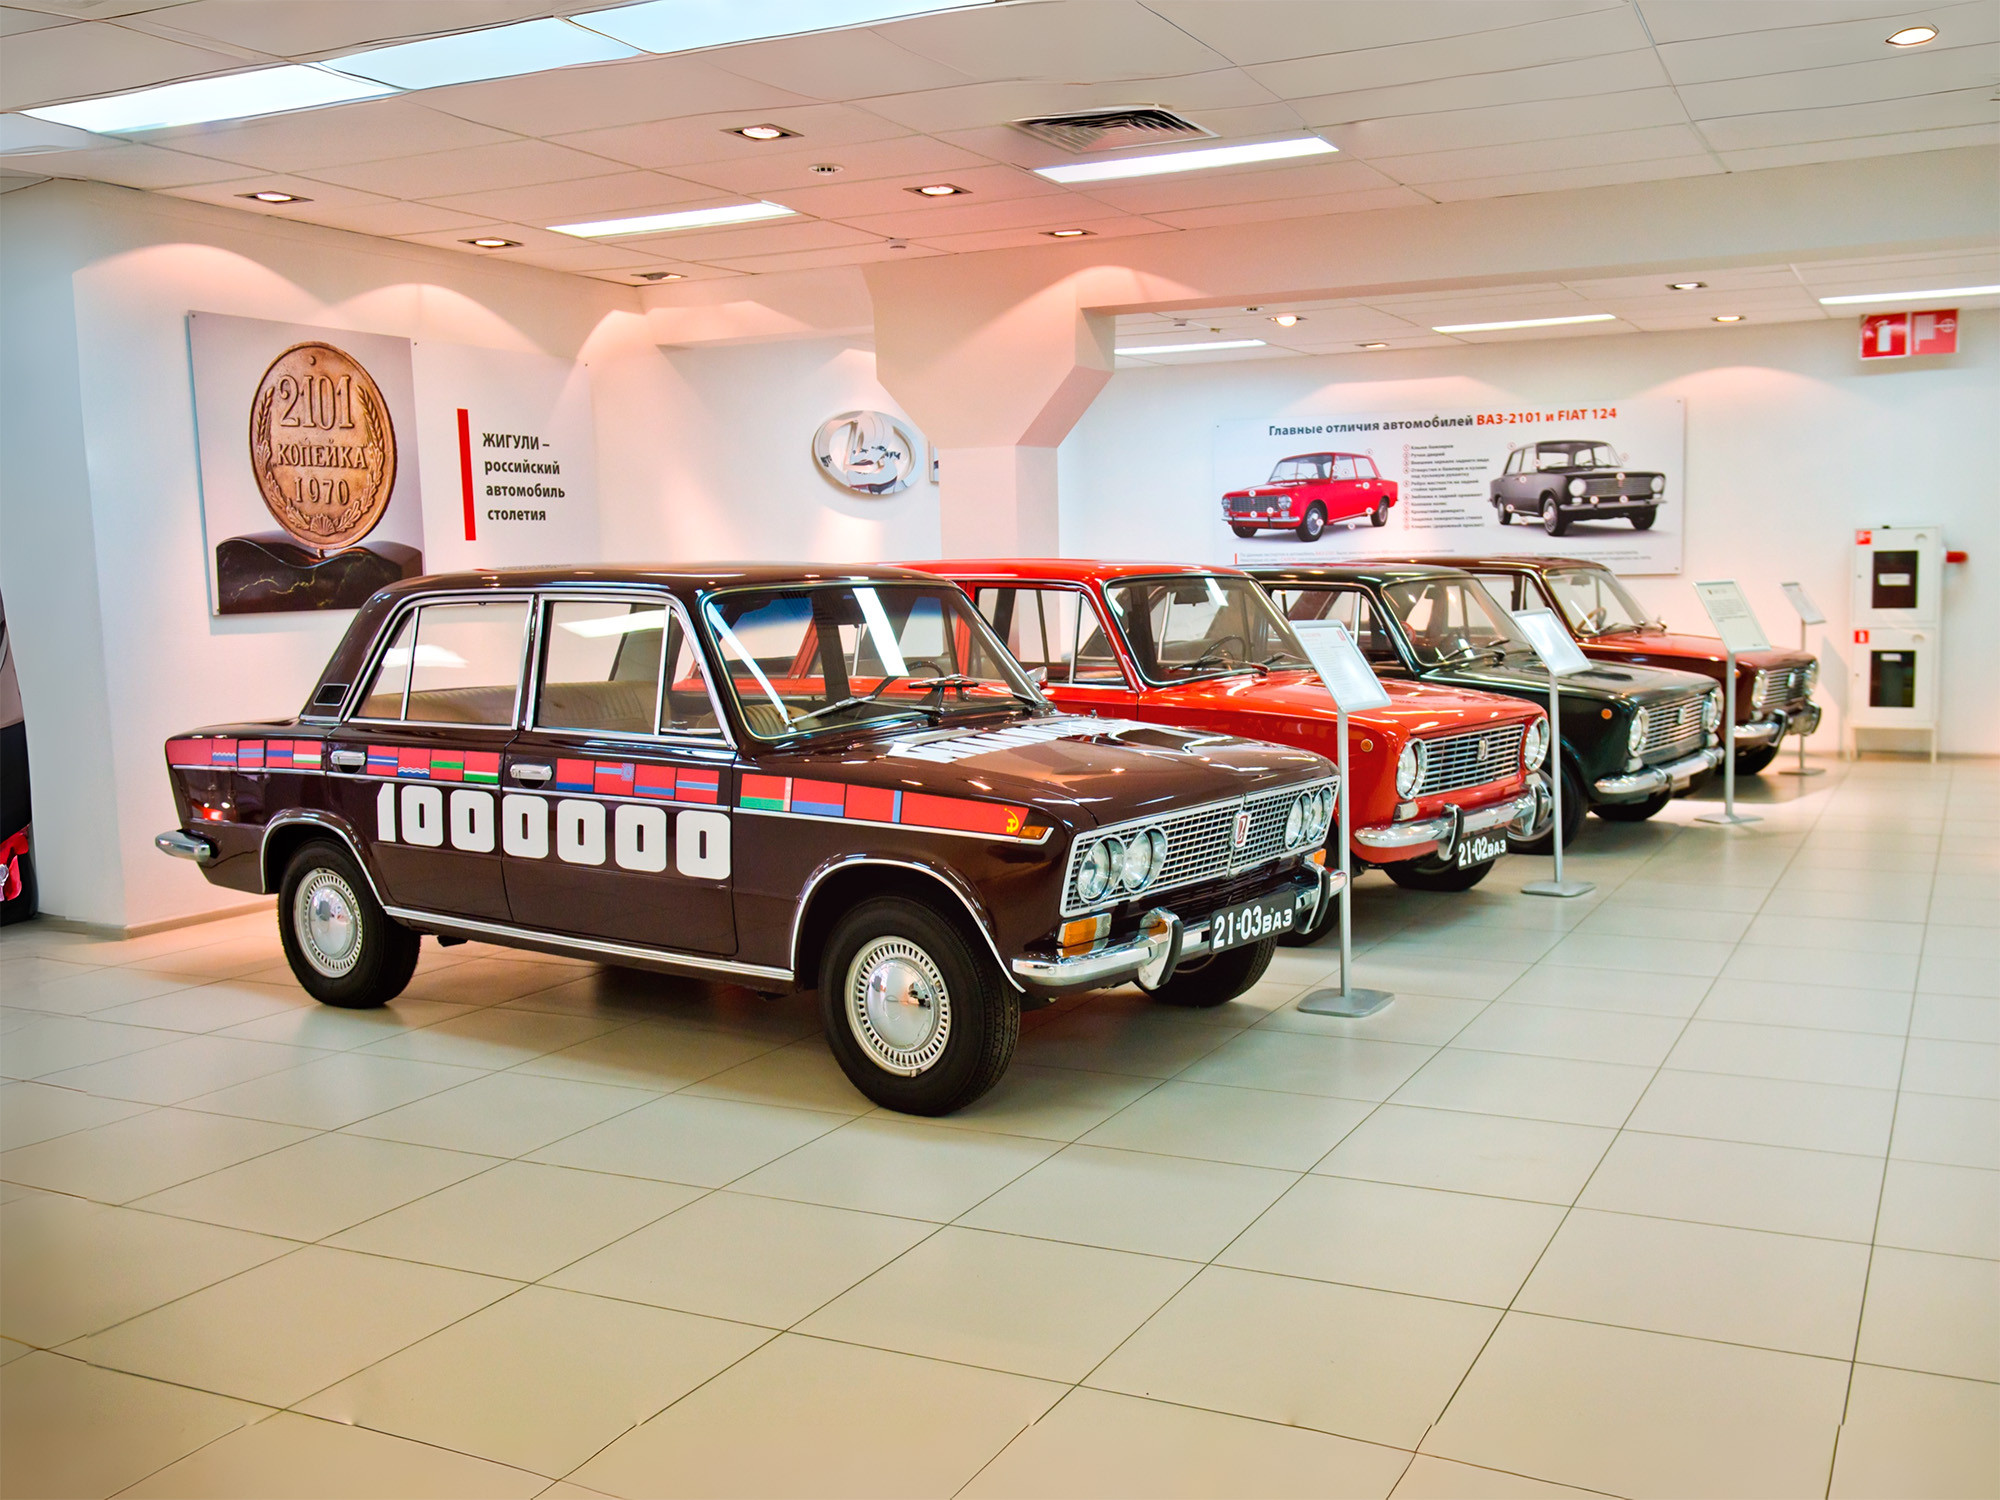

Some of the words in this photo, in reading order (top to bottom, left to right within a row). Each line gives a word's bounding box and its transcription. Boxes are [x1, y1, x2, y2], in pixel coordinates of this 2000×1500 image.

[278, 374, 355, 430] 2101
[1268, 425, 1323, 437] Главные
[1325, 420, 1380, 434] отличия
[1382, 414, 1473, 431] автомобилей
[1476, 411, 1542, 426] ВАЗ-2101
[1545, 413, 1554, 423] и
[1557, 409, 1588, 421] FIAT
[1592, 408, 1617, 420] 124
[277, 438, 369, 470] КОПЕЙКА
[482, 432, 540, 450] ЖИГУЛИ
[484, 459, 561, 476] российский
[294, 476, 351, 505] 1970
[486, 482, 566, 499] автомобиль
[487, 509, 547, 521] столетия
[376, 782, 731, 880] 1000000
